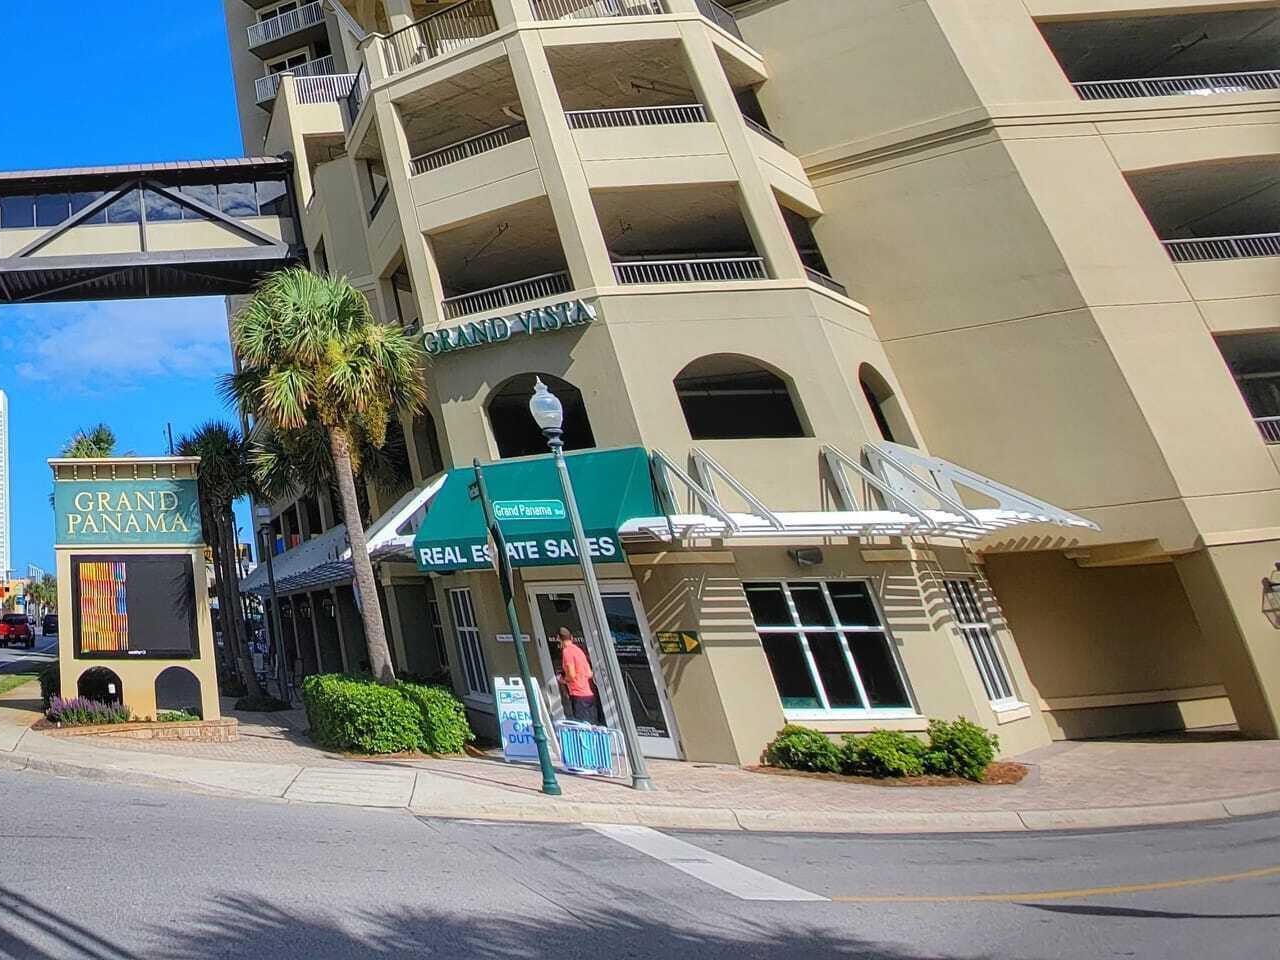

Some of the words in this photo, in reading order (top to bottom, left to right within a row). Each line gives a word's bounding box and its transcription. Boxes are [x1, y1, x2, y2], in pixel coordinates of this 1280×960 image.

[423, 315, 511, 355] GRAND
[519, 298, 597, 336] VISTA
[74, 490, 179, 512] GRAND
[495, 503, 519, 517] Grand
[519, 503, 553, 516] Panama
[66, 512, 190, 535] PANAMA
[420, 545, 468, 566] REAL
[471, 541, 540, 563] ESATE
[545, 536, 616, 559] SAES
[502, 711, 532, 721] AGEN
[512, 722, 530, 732] ON
